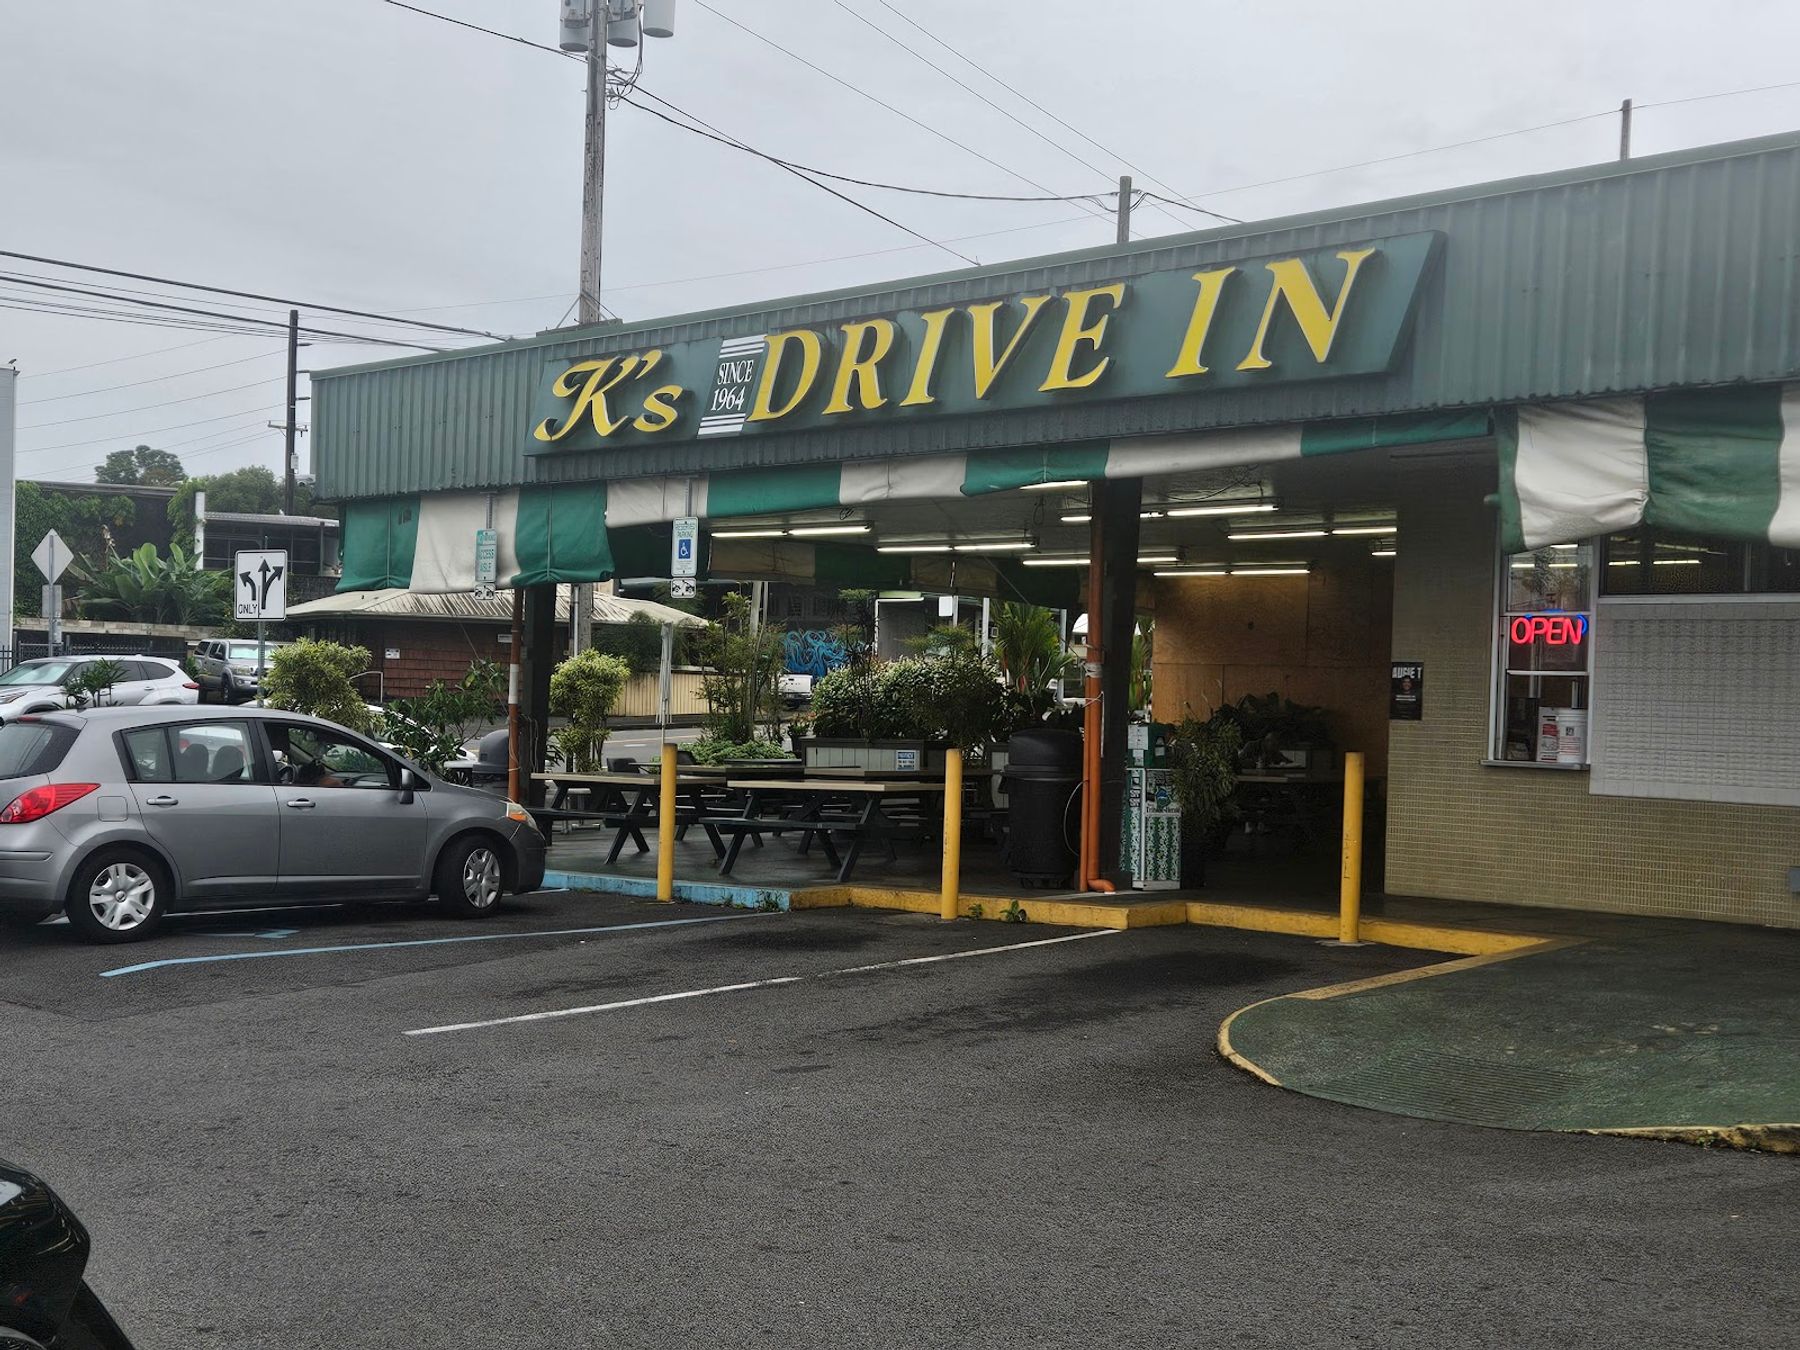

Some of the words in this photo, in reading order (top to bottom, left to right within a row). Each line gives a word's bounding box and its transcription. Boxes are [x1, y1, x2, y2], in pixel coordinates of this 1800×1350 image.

[533, 349, 684, 441] K's
[746, 282, 1126, 423] DRIVE
[1165, 246, 1376, 378] IN
[717, 359, 754, 385] SINCE
[710, 385, 746, 411] 1964
[238, 603, 258, 615] ONLY
[1511, 617, 1583, 645] OPEN
